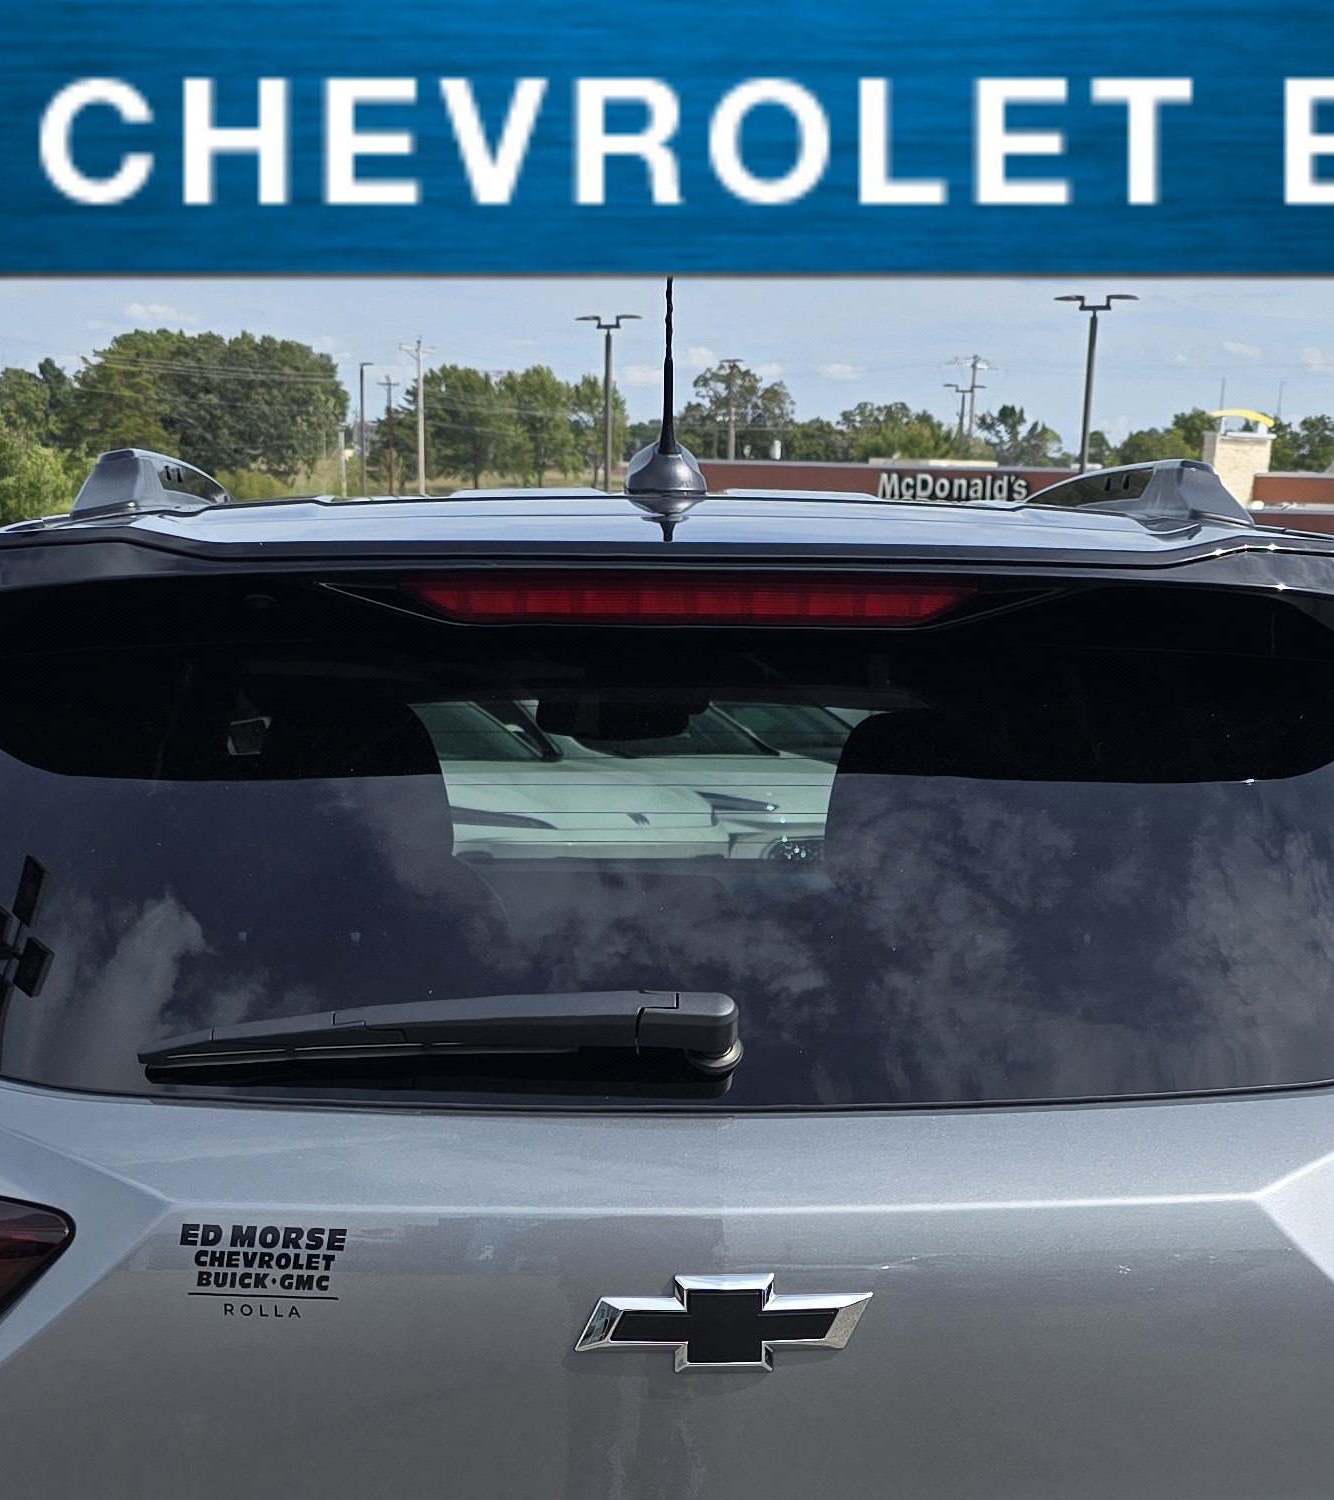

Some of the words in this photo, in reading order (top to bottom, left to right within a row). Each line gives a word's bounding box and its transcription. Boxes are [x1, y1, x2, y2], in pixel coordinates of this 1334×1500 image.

[878, 472, 1028, 500] McDonald's
[180, 1223, 223, 1246] ED
[230, 1225, 347, 1252] MORSE
[194, 1250, 335, 1272] CHEVROLET
[223, 1303, 301, 1319] ROLLA
